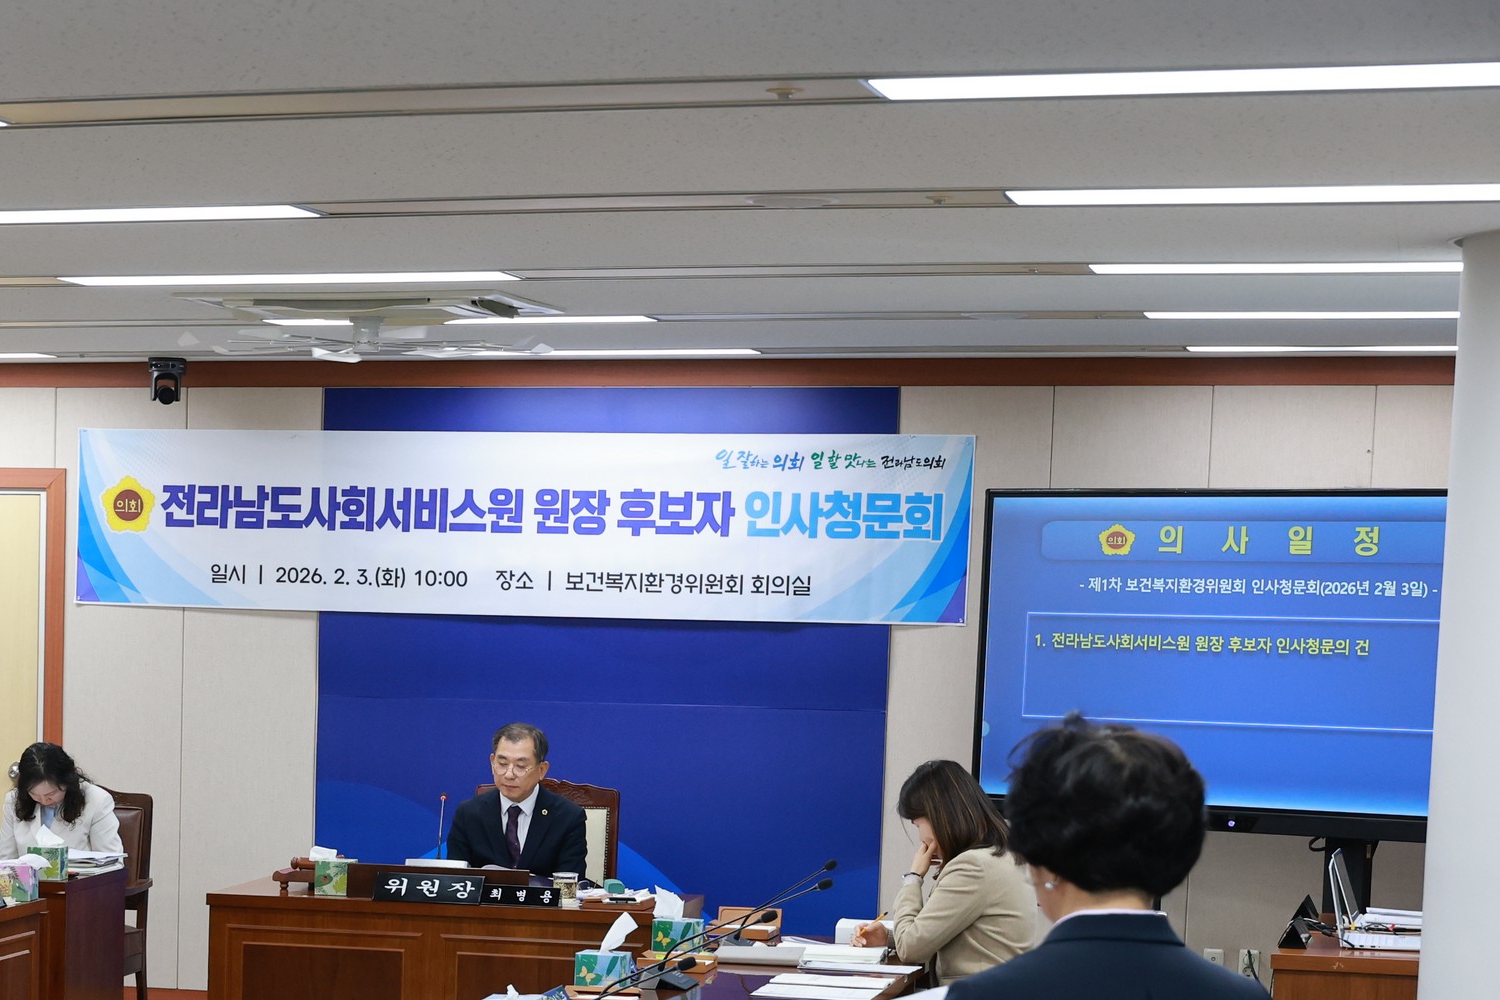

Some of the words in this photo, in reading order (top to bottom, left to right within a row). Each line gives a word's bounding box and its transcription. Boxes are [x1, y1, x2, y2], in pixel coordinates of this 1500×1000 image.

[715, 449, 736, 469] 일
[773, 451, 804, 472] 의회
[880, 455, 946, 471] 전라남도의회
[114, 498, 141, 513] 의회
[161, 484, 524, 534] 전라남도사회서비스원
[534, 488, 610, 536] 원장
[617, 489, 735, 537] 후보자
[745, 490, 943, 541] 인사청문회
[1107, 536, 1126, 545] 의회
[211, 564, 246, 585] 일시
[414, 570, 468, 587] 10:00
[496, 570, 534, 591] 장소
[565, 572, 744, 595] 보건복지환경위원회
[751, 574, 812, 596] 회의실
[1088, 577, 1122, 593] 제1차
[1125, 577, 1246, 594] 보건복지환경위원회
[1374, 580, 1396, 597] 2월
[1400, 581, 1428, 598] 3일)
[1035, 634, 1046, 647] 1.
[1051, 633, 1190, 652] 전라남도사회서비스원
[1195, 635, 1224, 652] 원장
[1228, 636, 1272, 654] 후보자
[1276, 637, 1350, 655] 인사청문의
[1355, 639, 1369, 656] 건
[384, 877, 476, 899] 위원장
[489, 887, 553, 904] 최병용
